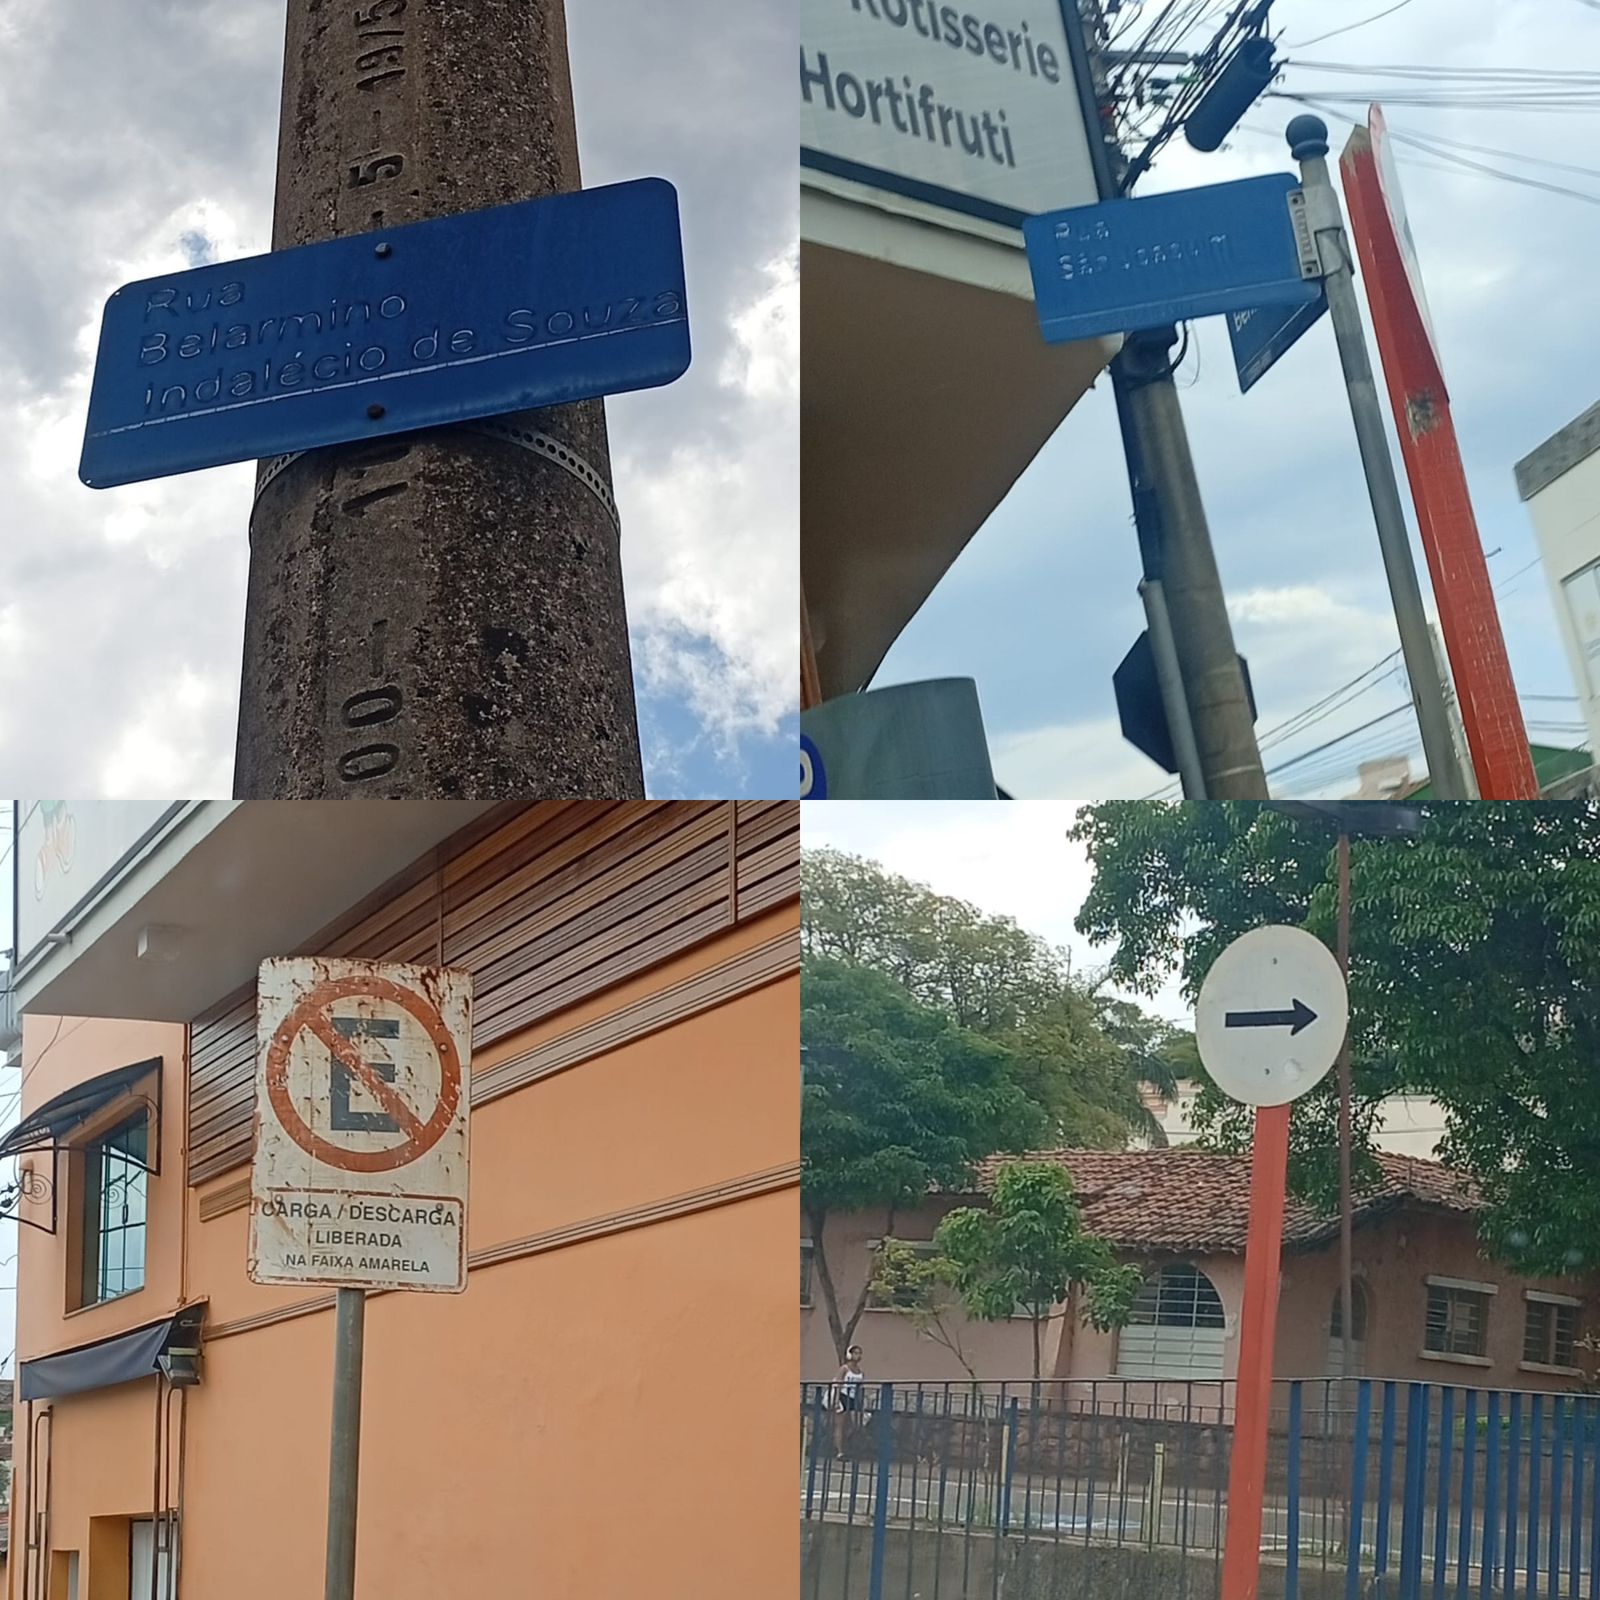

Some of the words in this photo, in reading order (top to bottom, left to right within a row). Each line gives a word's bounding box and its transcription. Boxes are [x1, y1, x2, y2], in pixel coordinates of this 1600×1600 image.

[851, 0, 1060, 84] otisserie
[800, 45, 1016, 168] Hortifruti
[144, 282, 244, 322] Rua
[139, 295, 406, 366] Belarmino
[144, 342, 386, 412] Indalécio
[412, 328, 475, 361] de
[505, 290, 681, 344] Souza
[261, 1201, 332, 1219] CARGA
[349, 1204, 456, 1226] DESCARGA
[315, 1230, 402, 1248] LIBERADA
[285, 1253, 307, 1267] NA
[311, 1254, 353, 1268] FAIXA
[358, 1256, 430, 1273] AMARELA
